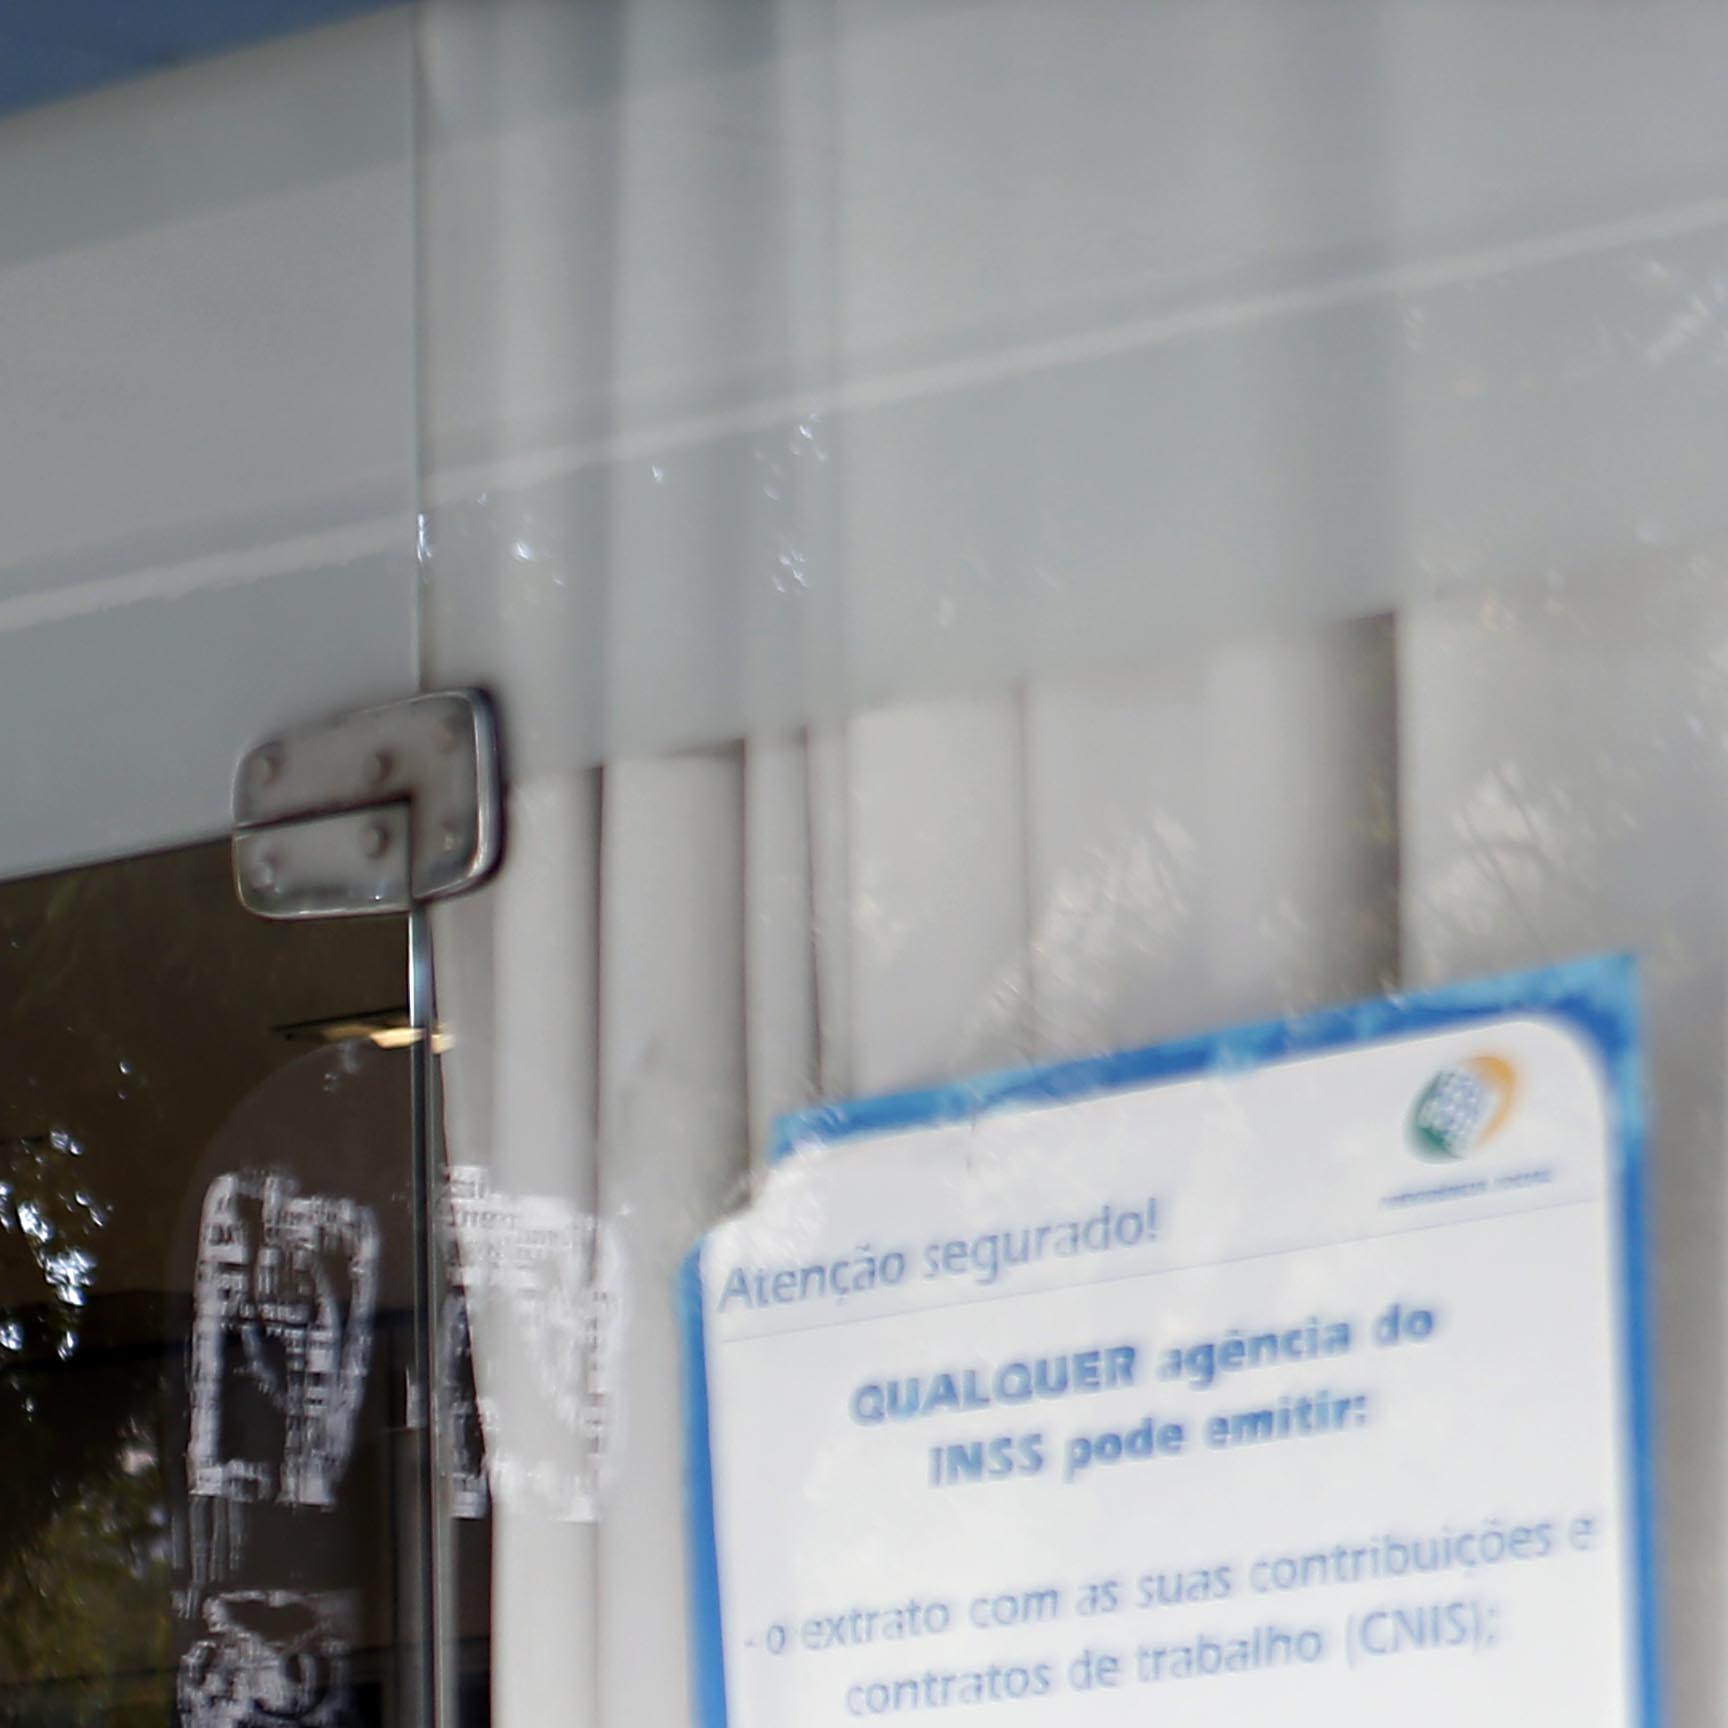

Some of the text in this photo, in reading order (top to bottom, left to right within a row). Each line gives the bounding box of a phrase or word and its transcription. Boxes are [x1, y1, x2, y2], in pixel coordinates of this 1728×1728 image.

[718, 1196, 1160, 1314] Atenção segurado!
[850, 1302, 1435, 1426] QUALQUER agência do
[928, 1388, 1367, 1488] INSS pode emitir:
[766, 1515, 1596, 1657] o extrato com as suas contribuições e
[845, 1657, 1051, 1720] contratos
[1069, 1645, 1119, 1692] de
[1135, 1624, 1324, 1684] trabalho
